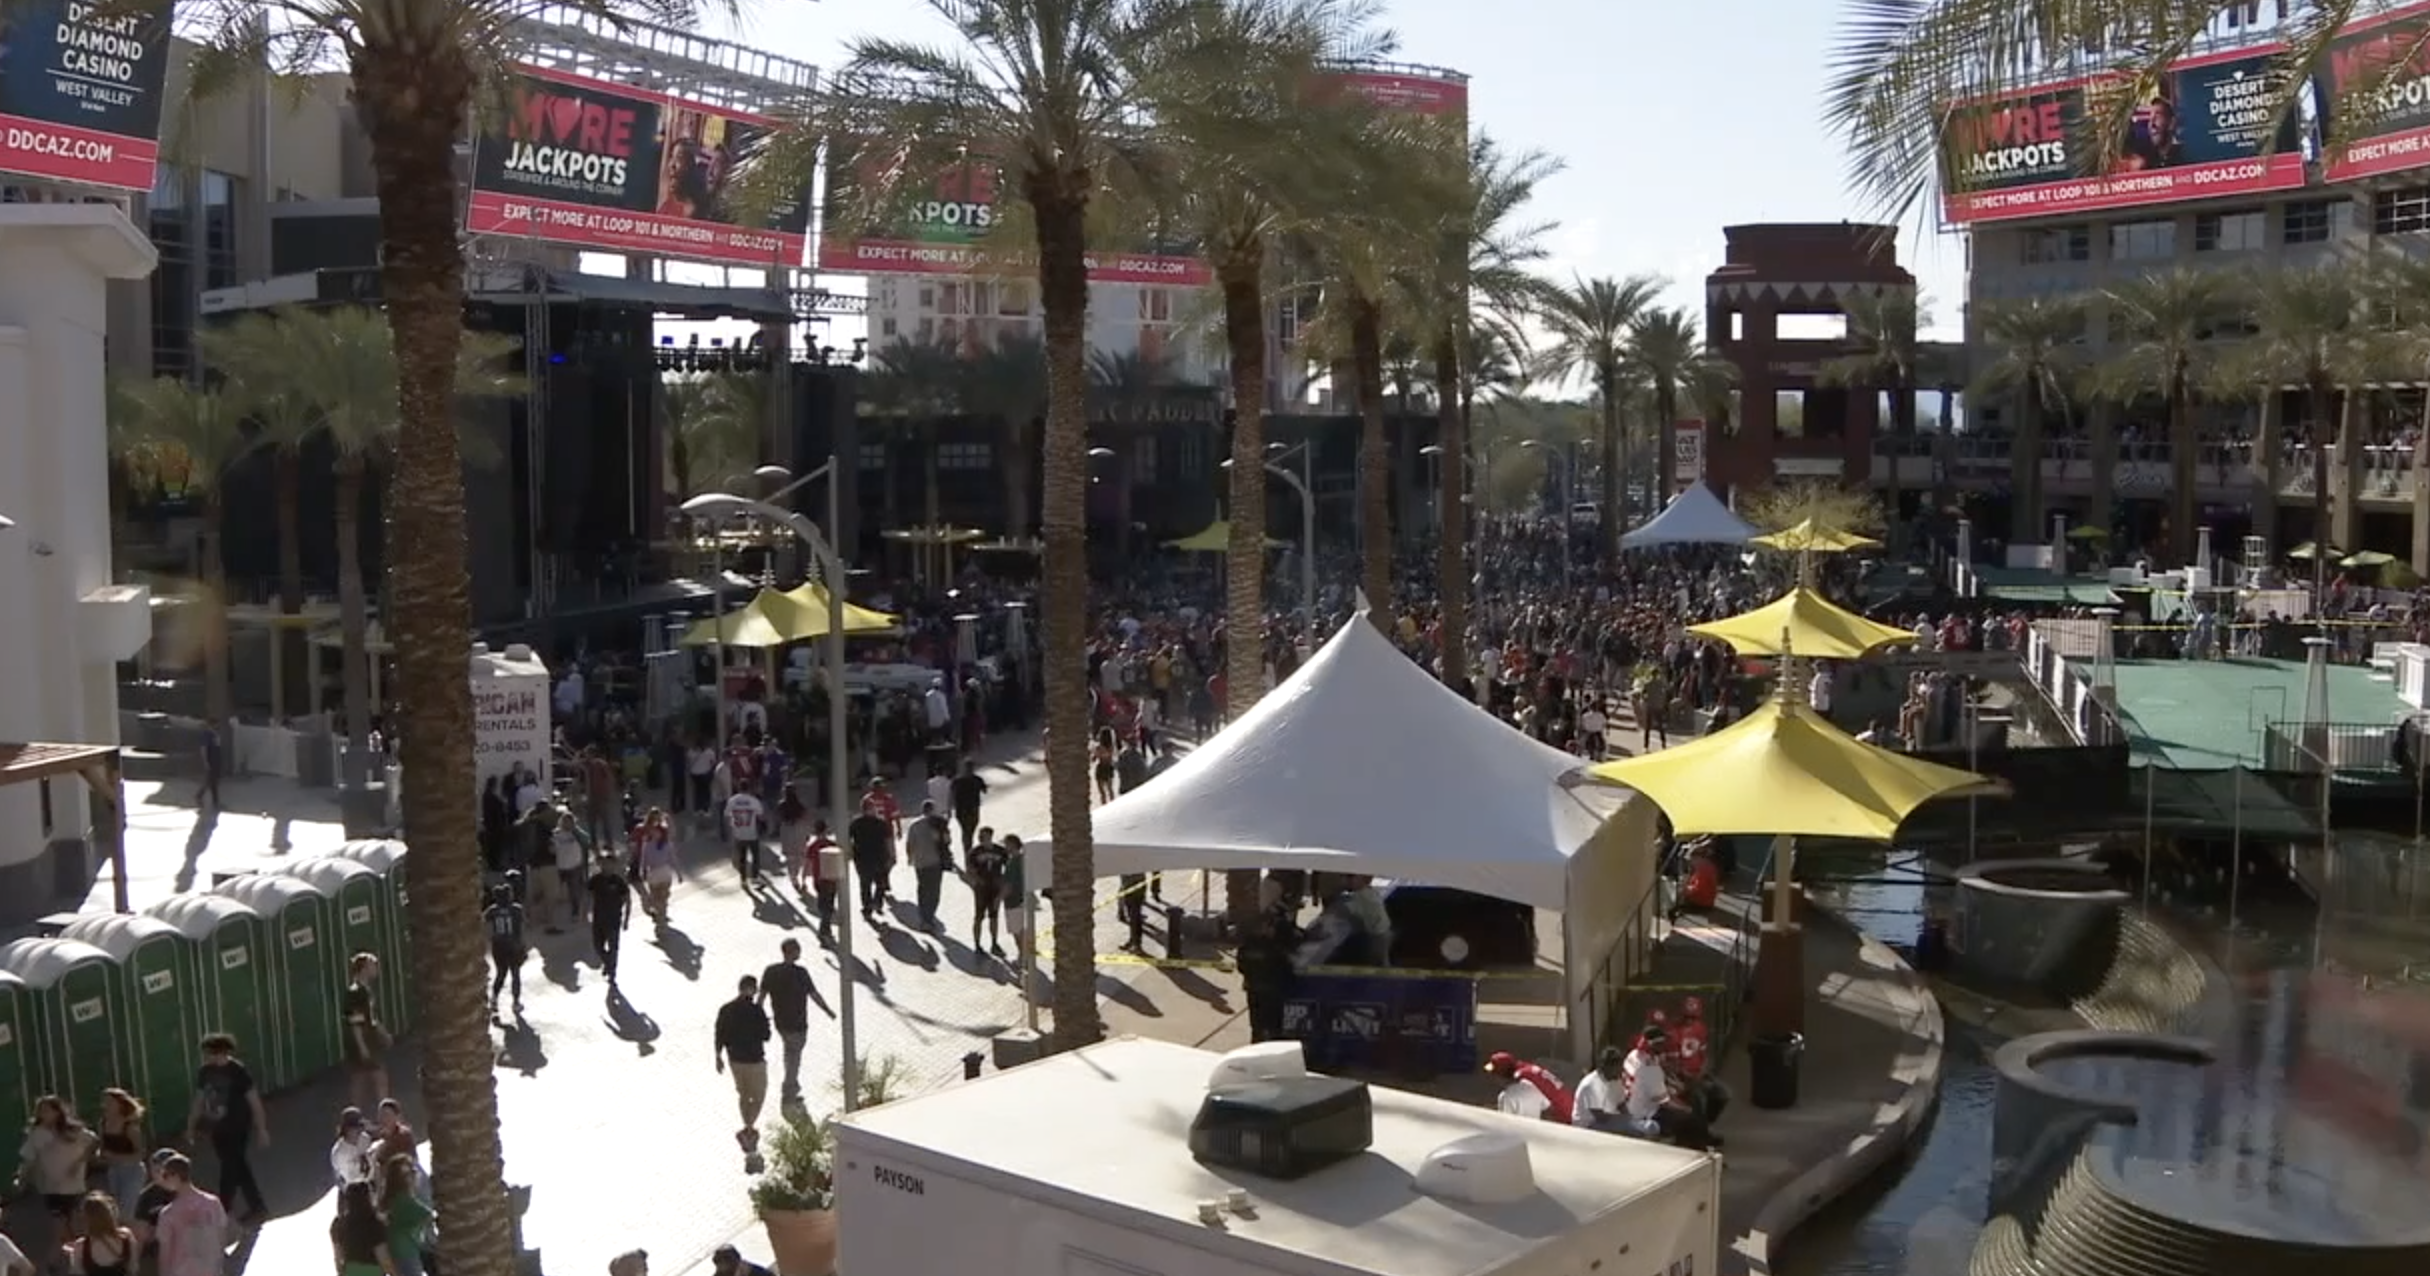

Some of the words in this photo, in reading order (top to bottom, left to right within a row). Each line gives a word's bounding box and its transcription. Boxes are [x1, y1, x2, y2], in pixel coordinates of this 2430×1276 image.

[57, 24, 143, 60] DIAMOND
[63, 50, 131, 81] CASINO
[56, 79, 88, 97] WEST
[91, 87, 133, 107] VALLEY
[2210, 92, 2275, 115] DIAMOND
[2214, 79, 2265, 99] DESERT
[2218, 109, 2269, 127] CASINO
[8, 129, 113, 162] DDCAZ.COM
[1961, 141, 2065, 175] ACKPOTS
[2348, 145, 2387, 163] EXPECT
[2389, 138, 2421, 156] MORE
[504, 141, 627, 185] JACKPOTS
[2008, 191, 2035, 205] MORE
[2037, 190, 2052, 202] AT
[2053, 187, 2082, 201] LOOP
[2112, 175, 2173, 195] NORTHERN
[2194, 163, 2267, 184] DDCAZ.COM
[551, 210, 584, 226] MORE
[586, 214, 602, 229] AT
[603, 217, 632, 232] LOOP
[635, 221, 650, 234] 101
[661, 224, 714, 242] NORTHERN
[908, 201, 991, 226] KPOTS
[857, 245, 906, 259] EXPECT
[910, 249, 944, 263] MORE
[949, 251, 966, 262] AT
[1119, 259, 1185, 273] DDCAZ.COM
[474, 693, 536, 715] RICAN
[874, 1165, 924, 1195] PAYSON
